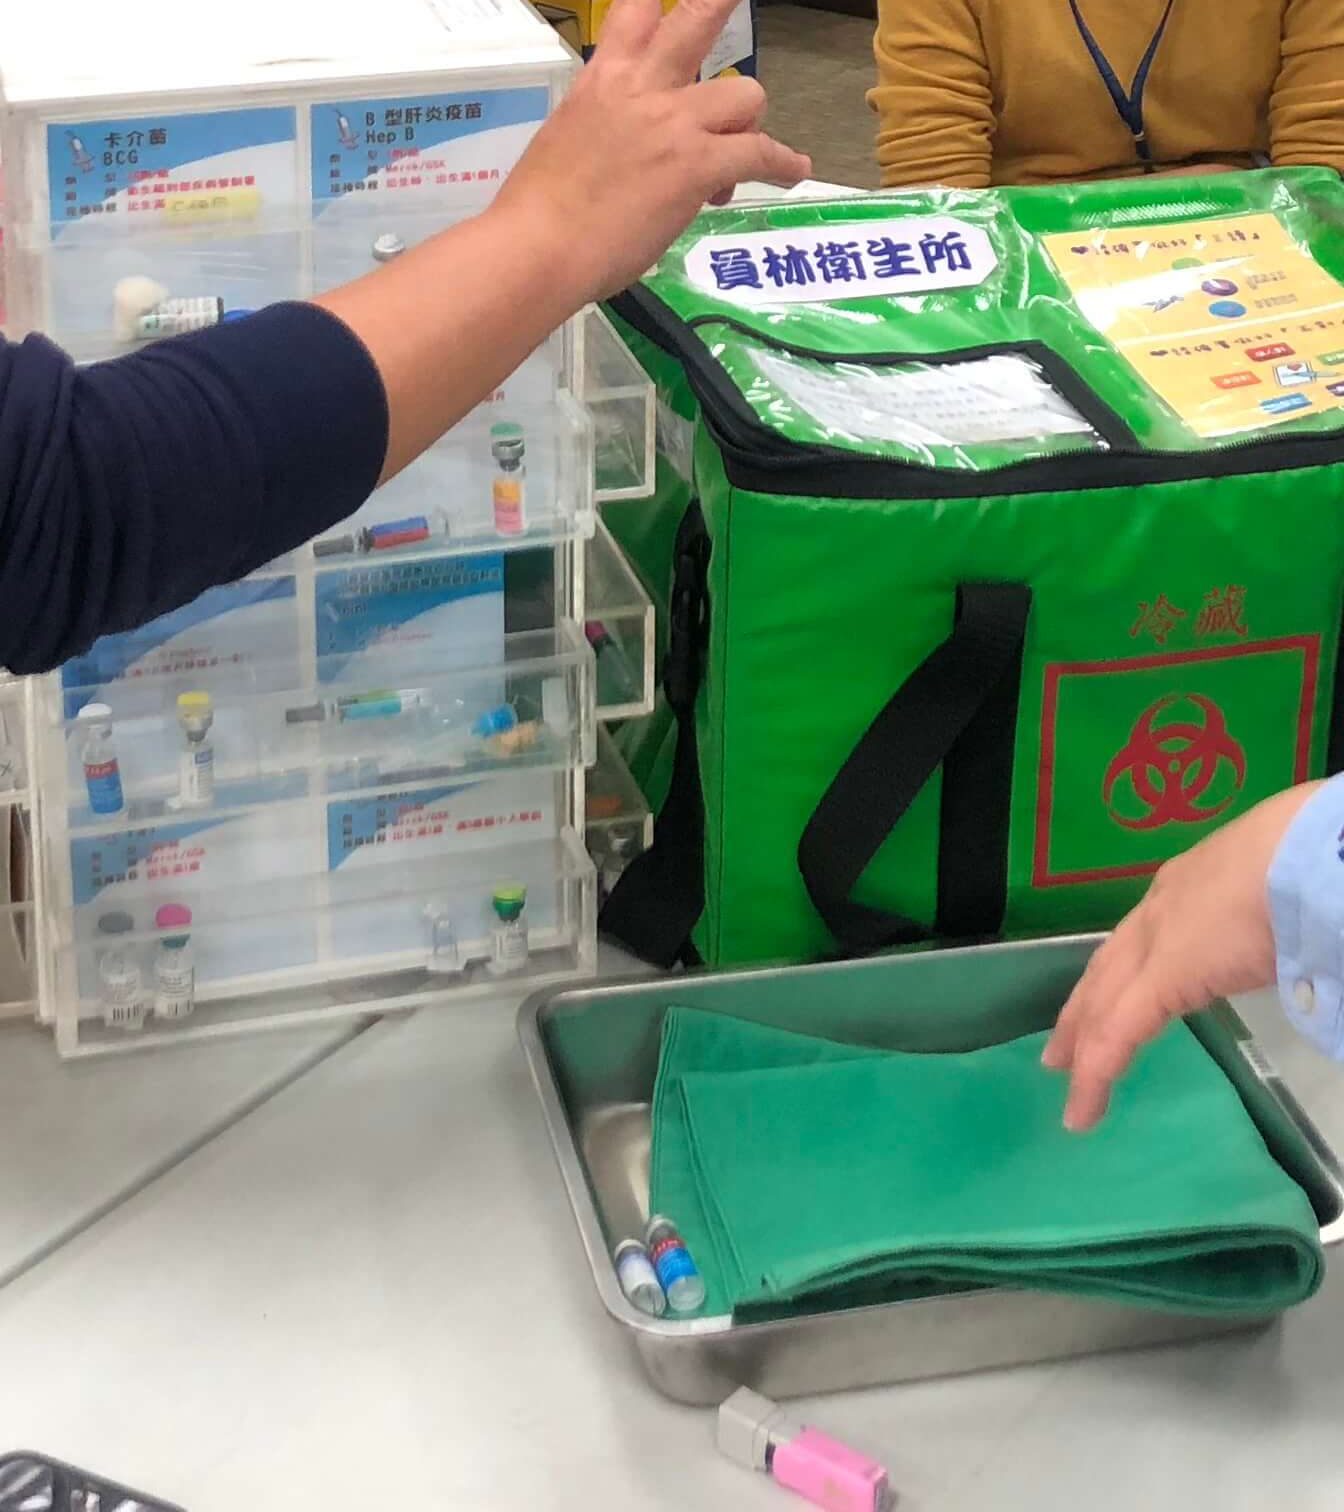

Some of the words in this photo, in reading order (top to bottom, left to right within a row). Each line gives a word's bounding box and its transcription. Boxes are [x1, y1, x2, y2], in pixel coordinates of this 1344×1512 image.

[365, 111, 375, 127] B
[385, 102, 482, 127] 型肝炎疫苗
[104, 127, 167, 148] 卡介苗
[367, 129, 397, 146] Hep
[406, 127, 415, 141] B
[103, 150, 139, 166] BCG
[709, 231, 973, 290] 員林衛生所
[1130, 583, 1248, 645] 冷藏
